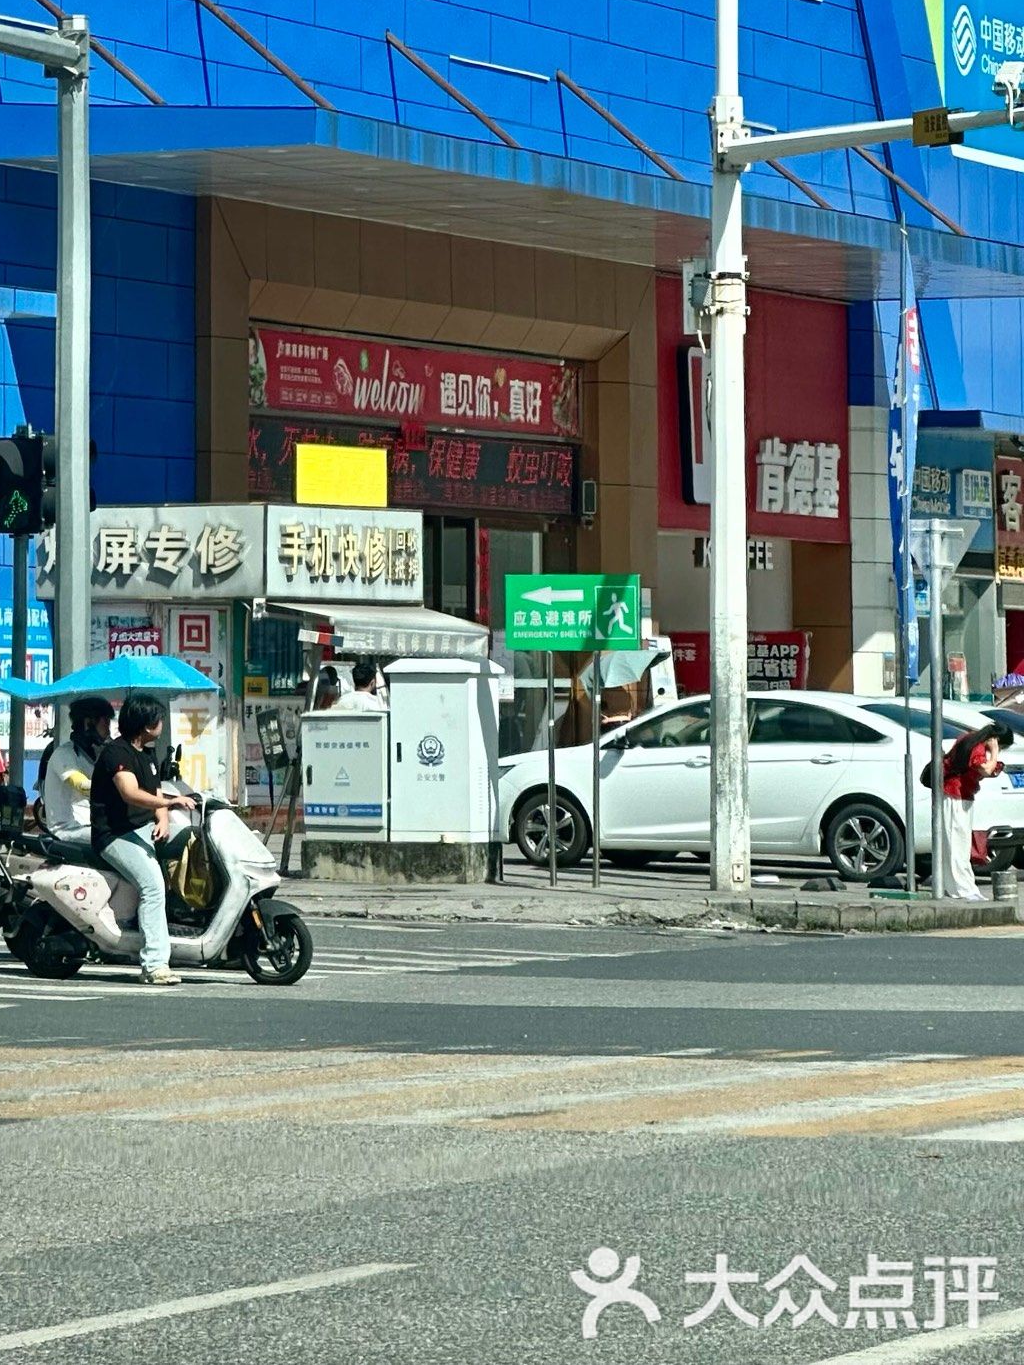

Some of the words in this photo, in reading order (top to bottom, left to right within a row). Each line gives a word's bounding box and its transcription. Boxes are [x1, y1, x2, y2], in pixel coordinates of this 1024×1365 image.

[758, 437, 841, 518] 肯德基
[283, 523, 385, 578] 手机快修
[513, 609, 592, 627] 应急避难所
[513, 630, 558, 639] EMERGENCY
[416, 773, 446, 782] 公安交警
